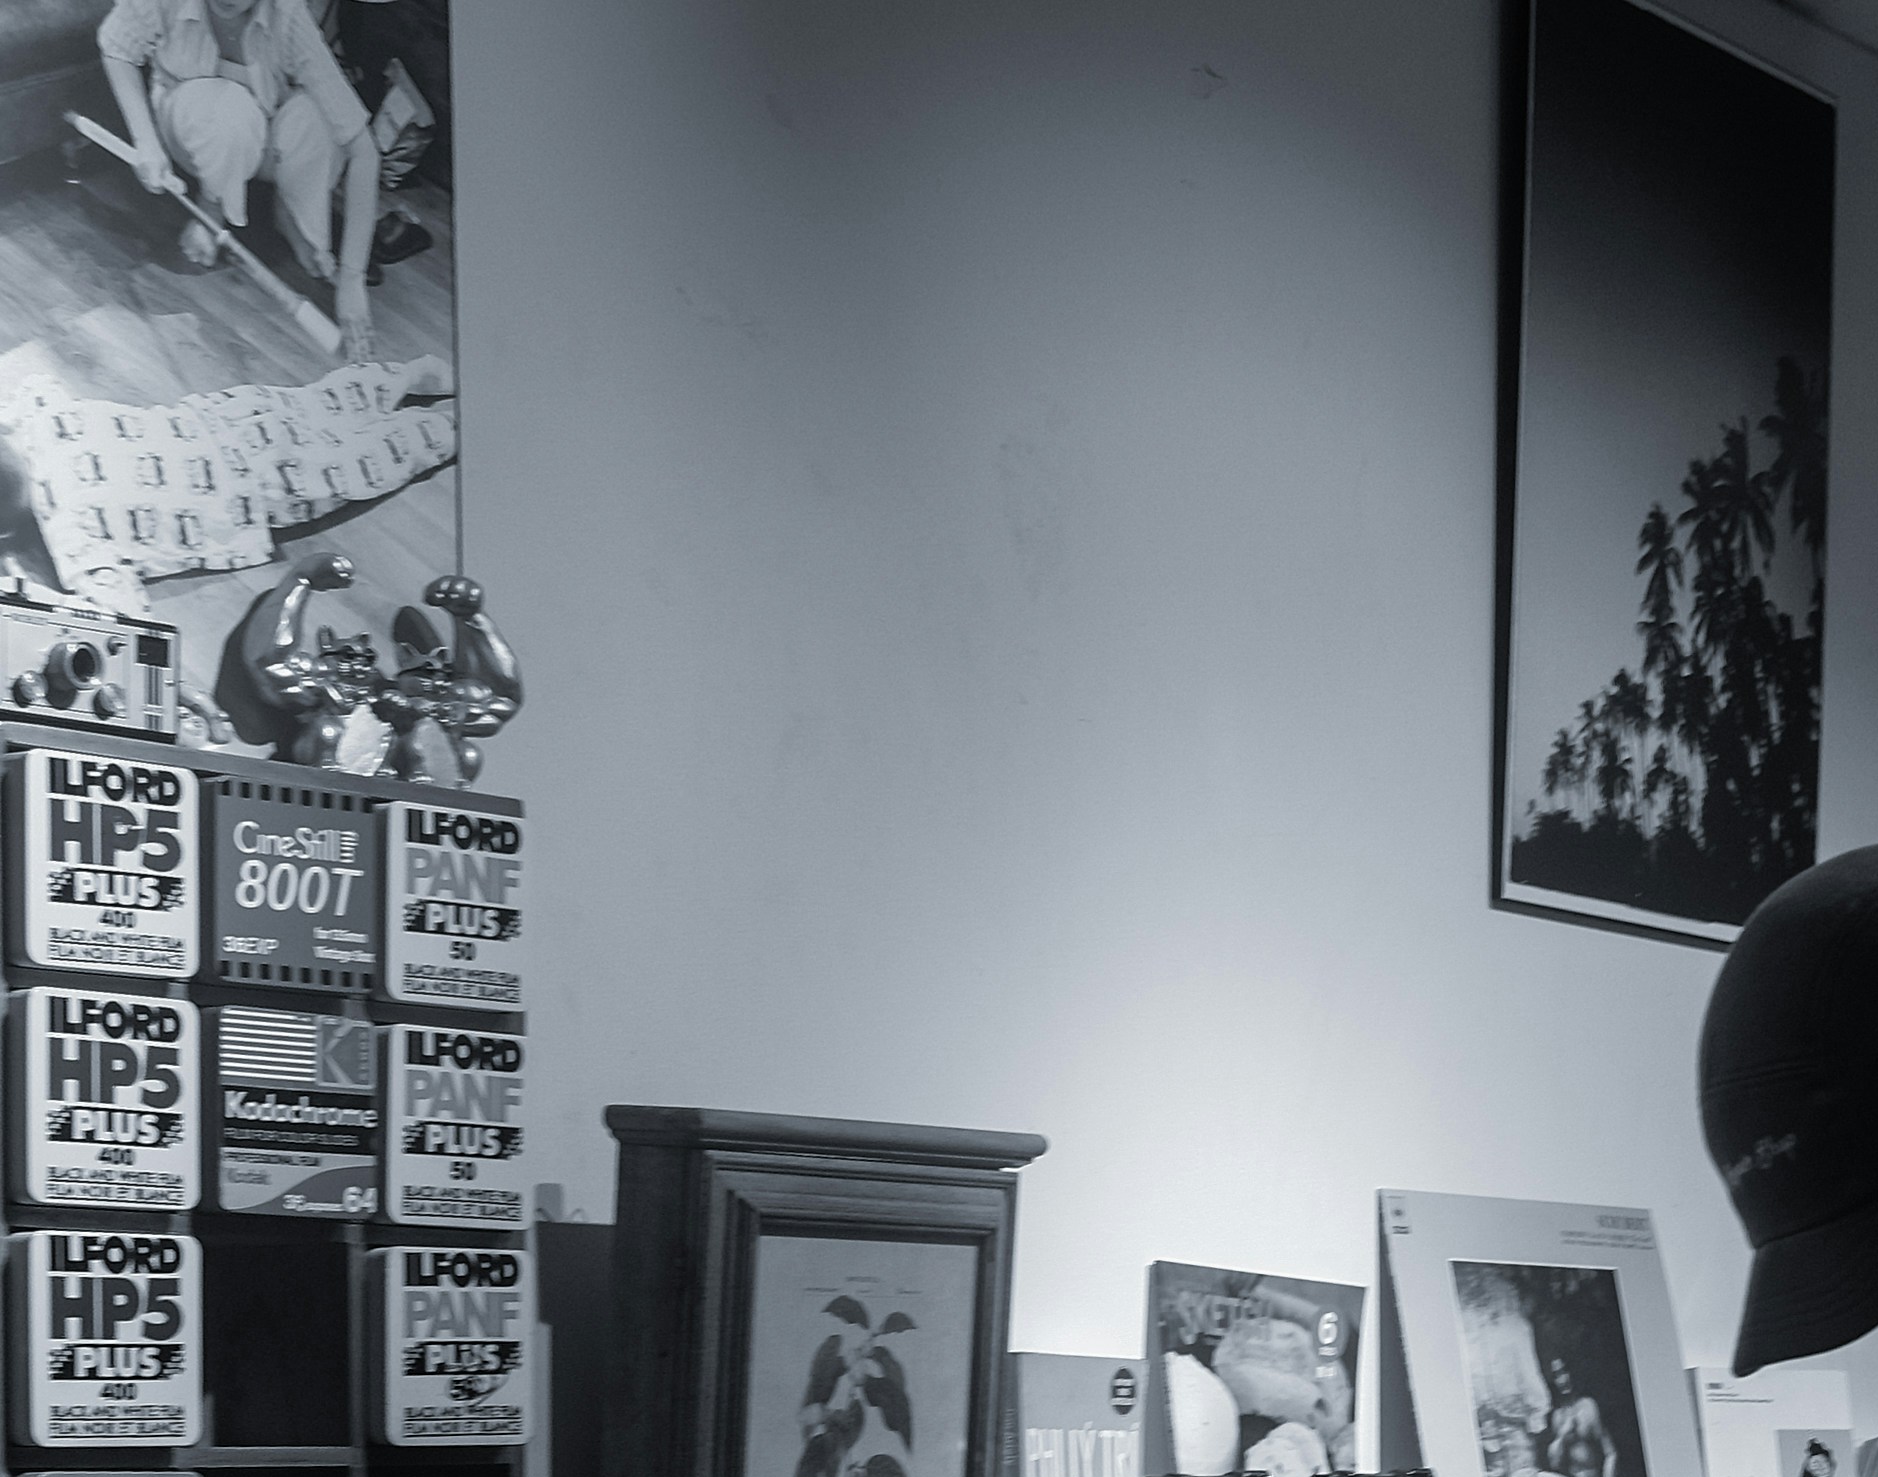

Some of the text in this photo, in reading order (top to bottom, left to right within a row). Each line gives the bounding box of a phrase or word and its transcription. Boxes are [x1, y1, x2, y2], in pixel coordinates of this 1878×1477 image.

[49, 800, 181, 872] HP5
[73, 871, 161, 908] PLUS
[235, 859, 365, 916] 800T
[424, 904, 500, 938] PLUS
[49, 1039, 181, 1109] HP5
[70, 1109, 161, 1144] PLUS
[424, 1124, 500, 1156] PLUS
[51, 1276, 181, 1341] HP5
[1317, 1311, 1339, 1345] 6
[73, 1347, 162, 1377] PLUS
